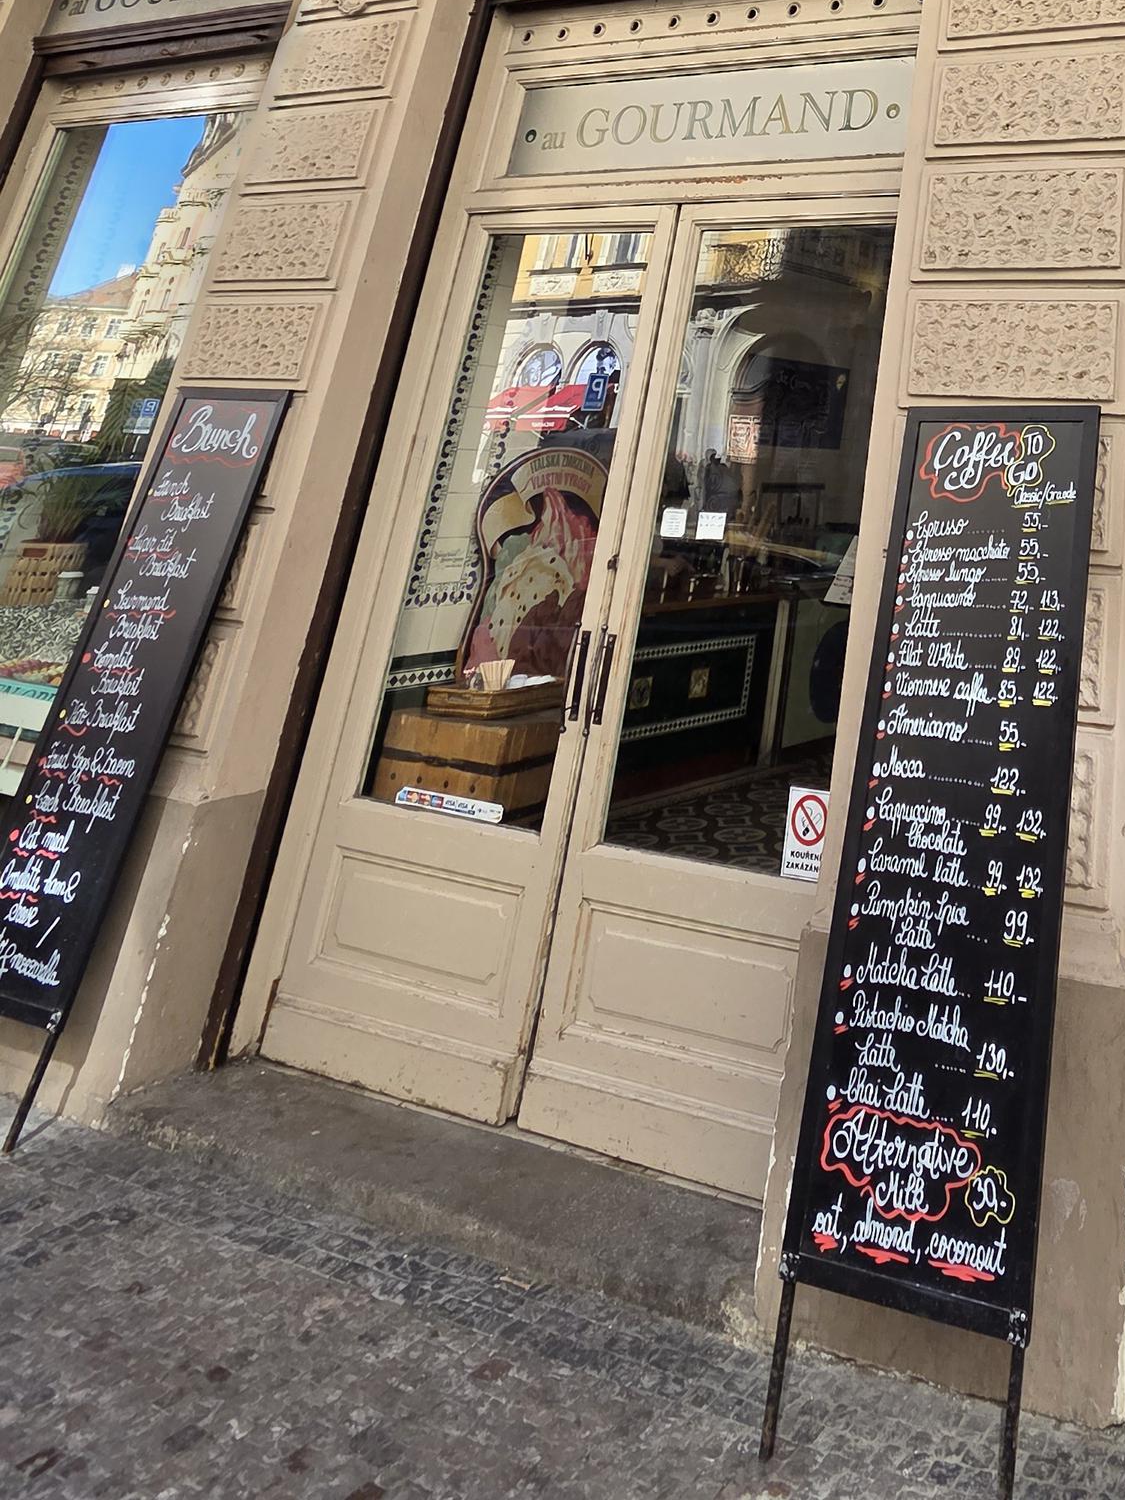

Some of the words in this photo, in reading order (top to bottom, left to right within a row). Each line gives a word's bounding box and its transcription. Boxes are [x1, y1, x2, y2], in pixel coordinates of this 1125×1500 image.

[541, 131, 565, 151] au
[576, 88, 879, 149] GOURMAND
[171, 405, 258, 458] Brunch
[934, 431, 1015, 490] Coffee
[1024, 432, 1043, 455] TO
[1008, 461, 1038, 486] GO
[945, 560, 986, 599] lungo
[906, 583, 976, 621] Cappuccino
[905, 609, 941, 638] Latte
[896, 641, 923, 668] Flat
[928, 640, 968, 670] White
[887, 704, 968, 743] Americano
[881, 745, 925, 779] Mocca
[875, 786, 946, 838] Cappuccino
[868, 838, 928, 876] Caramel
[906, 824, 967, 856] Chocolate
[861, 880, 933, 935] Pumpkin
[895, 919, 936, 951] Latte
[856, 942, 920, 992] Matcha
[849, 990, 915, 1034] Pistachio
[916, 1003, 971, 1052] Matcha
[855, 1032, 900, 1072] Latte
[840, 1066, 882, 1110] Chai
[883, 1071, 930, 1120] Latte
[832, 1109, 975, 1179] Alternative
[875, 1171, 929, 1213] Milk
